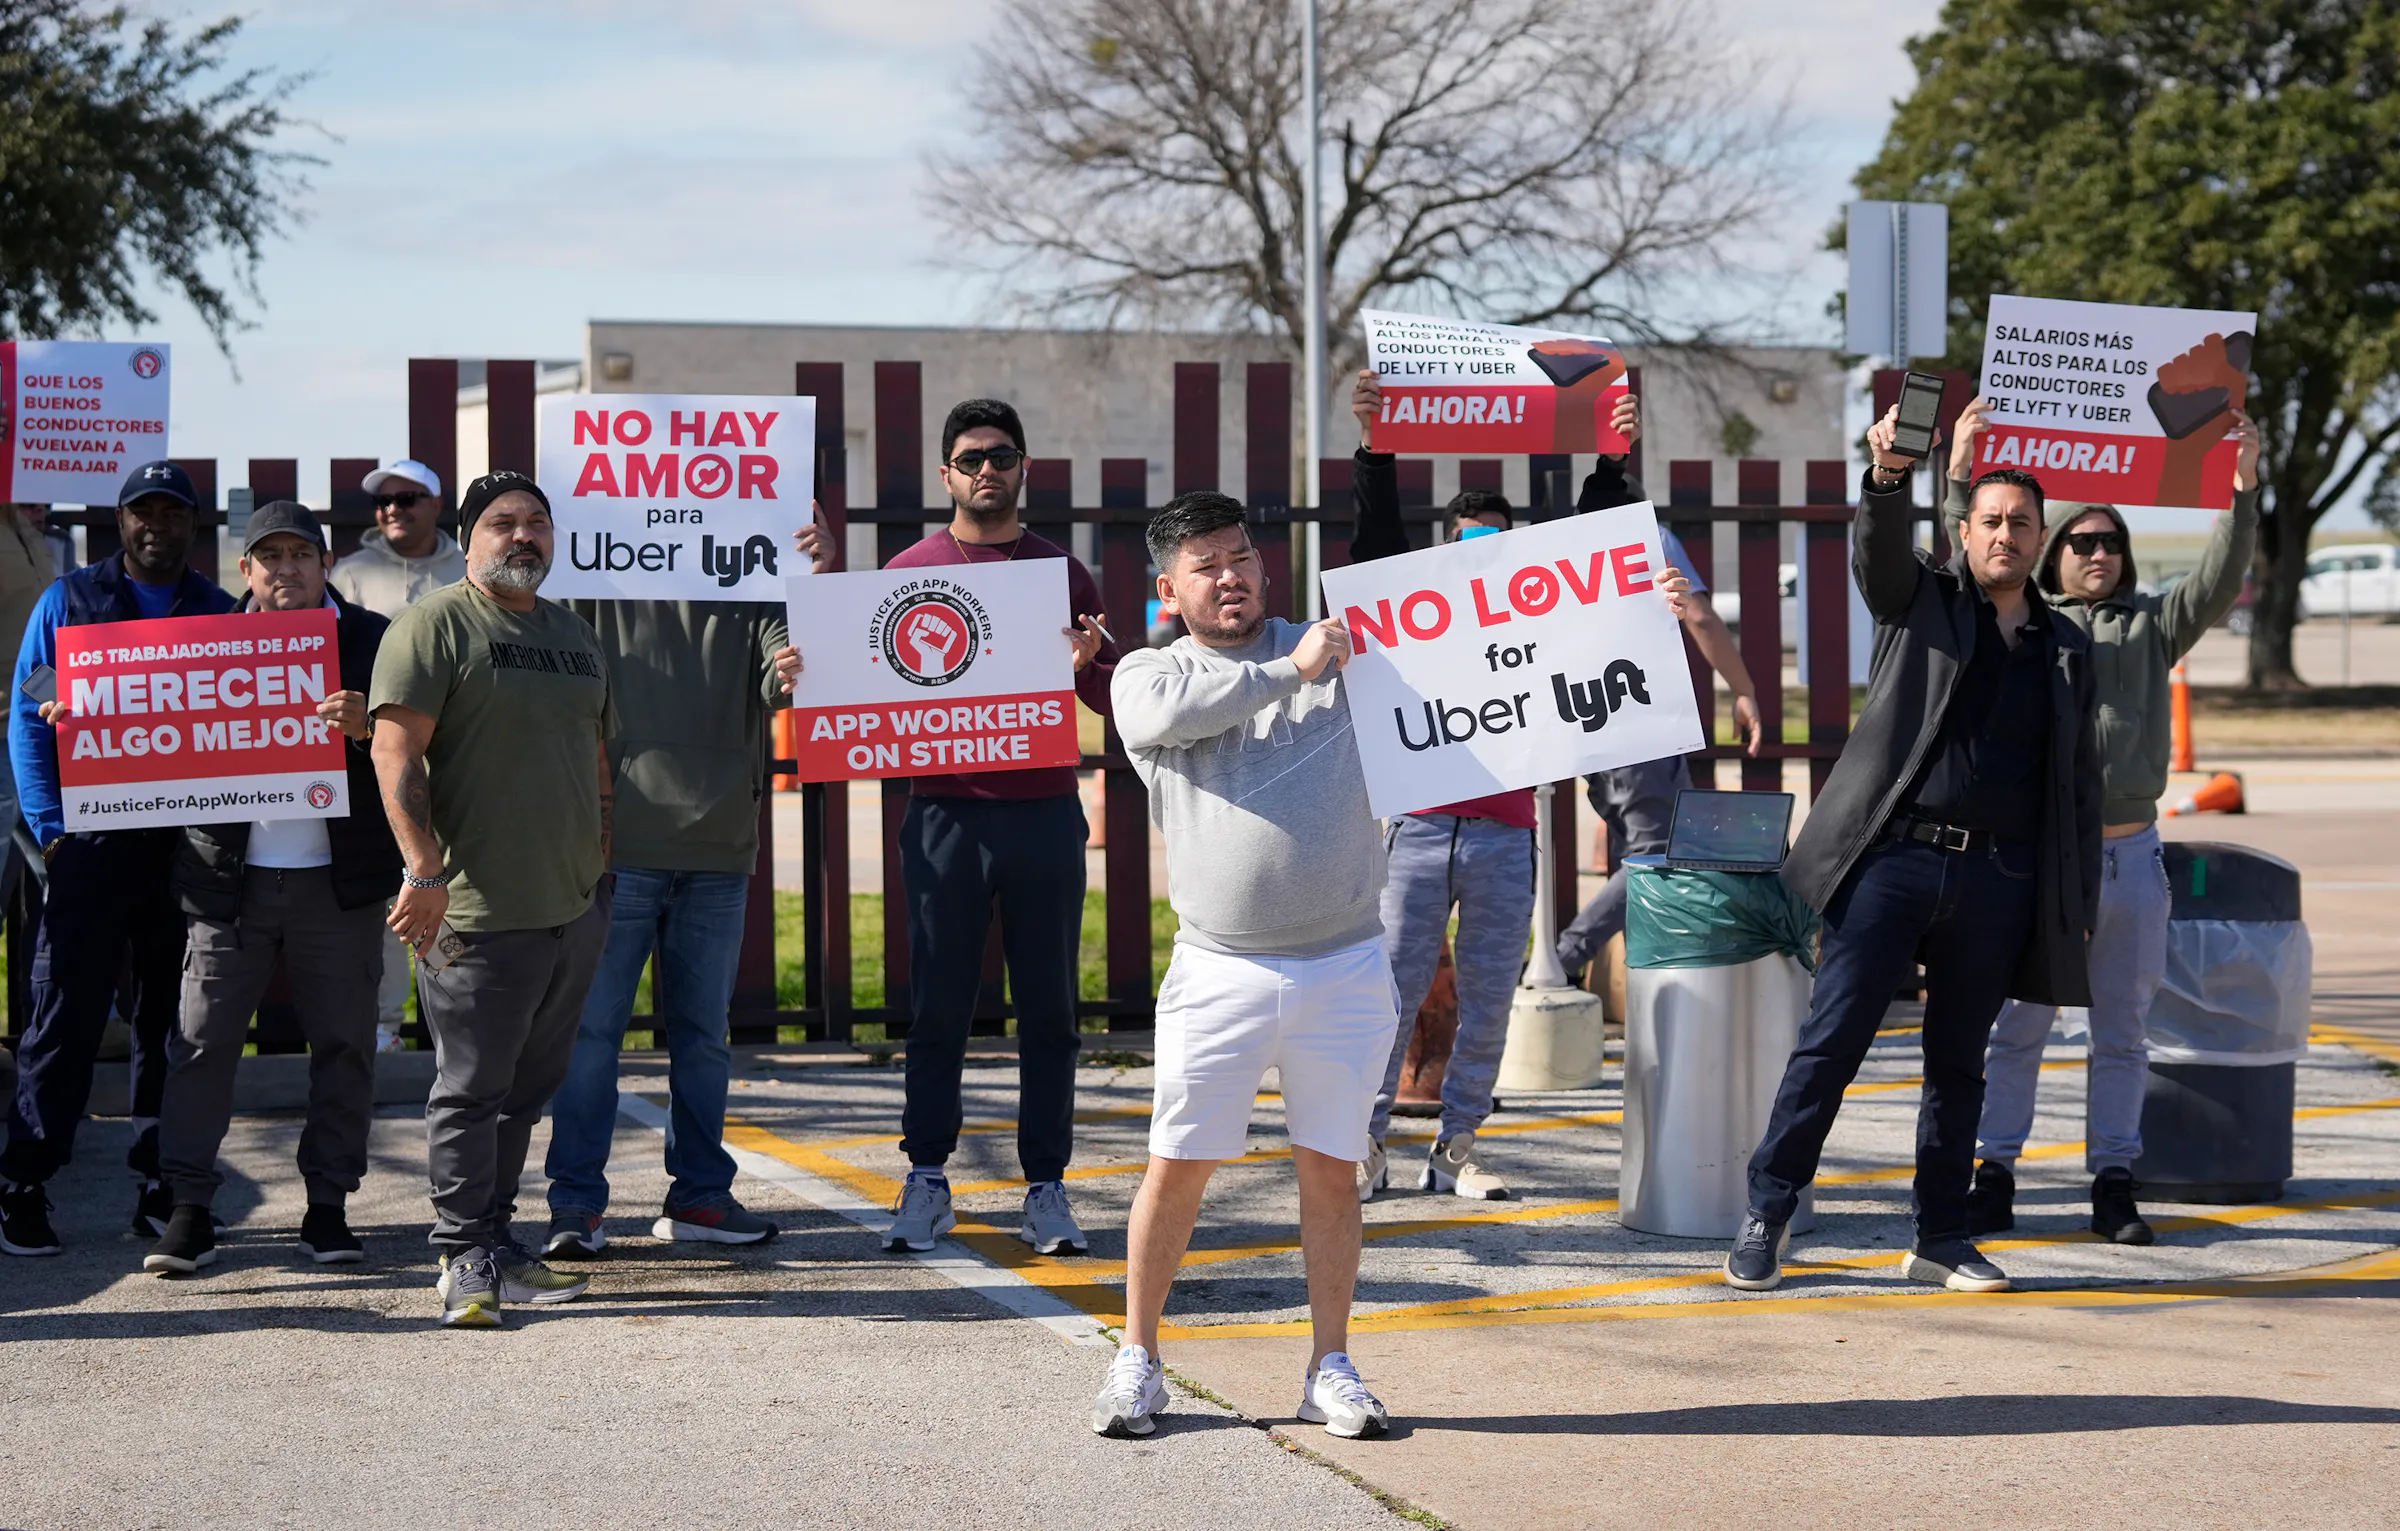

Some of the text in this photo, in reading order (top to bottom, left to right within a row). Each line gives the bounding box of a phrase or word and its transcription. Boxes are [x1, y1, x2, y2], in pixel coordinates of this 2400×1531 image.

[1372, 319, 1461, 332] SALARIOS
[1376, 329, 1522, 346] ALTOS PARA LOS
[1995, 325, 2134, 350] SALARIOS MÁS
[1377, 342, 1506, 356] CONDUCTORES
[1992, 349, 2148, 376] ALTOS PARA LOS
[24, 375, 104, 390] QUE LOS
[1379, 361, 1516, 376] DE LYFT Y UBER
[1989, 373, 2126, 399] CONDUCTORES
[24, 396, 102, 411] BUENOS
[1380, 395, 1527, 425] ¡AHORA!
[1987, 396, 2132, 423] DE LYFT Y UBER
[23, 417, 165, 434] CONDUCTORES
[573, 409, 780, 447] NO HAY
[22, 437, 126, 453] VUELVAN A
[1982, 433, 2137, 475] ¡AHORA!
[21, 457, 119, 474] TRABAJAR
[572, 452, 780, 500] AMOR
[646, 508, 704, 529] para
[570, 531, 778, 588] Uber lyft
[1344, 542, 1655, 656] NO LOVE
[869, 579, 993, 650] JUSTICE FOR APP WORKERS
[69, 635, 325, 668] LOS TRABAJADORES DE APP
[488, 641, 602, 681] AMERICAN EAGLE
[1484, 641, 1538, 673] for
[71, 663, 326, 718] MERECEN
[1394, 690, 1531, 752] Uber
[1550, 658, 1652, 733] lyft
[810, 700, 1064, 742] APP WORKERS
[71, 715, 331, 761] ALGO MEJOR
[847, 734, 1031, 771] ON STRIKE
[79, 789, 295, 816] #JusticeForAppWorkers
